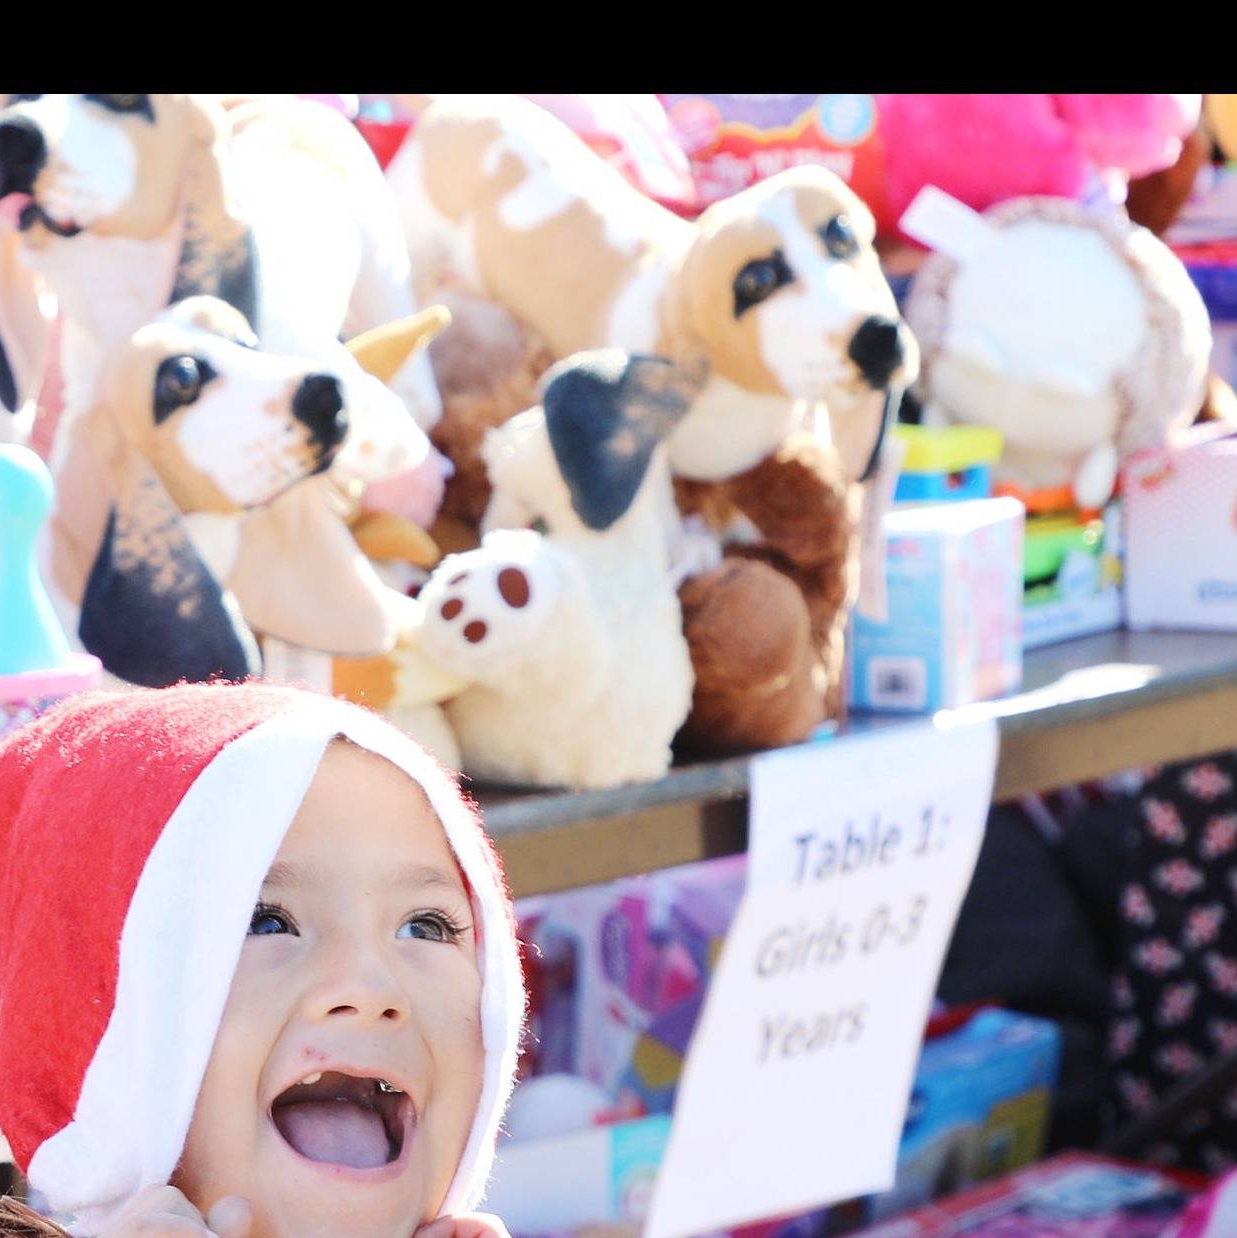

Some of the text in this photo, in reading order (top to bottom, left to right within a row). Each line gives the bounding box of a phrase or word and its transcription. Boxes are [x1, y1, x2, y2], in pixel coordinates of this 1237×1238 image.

[792, 806, 952, 884] Table 1:
[755, 892, 928, 980] Girls 0-3
[757, 1002, 868, 1064] Years
